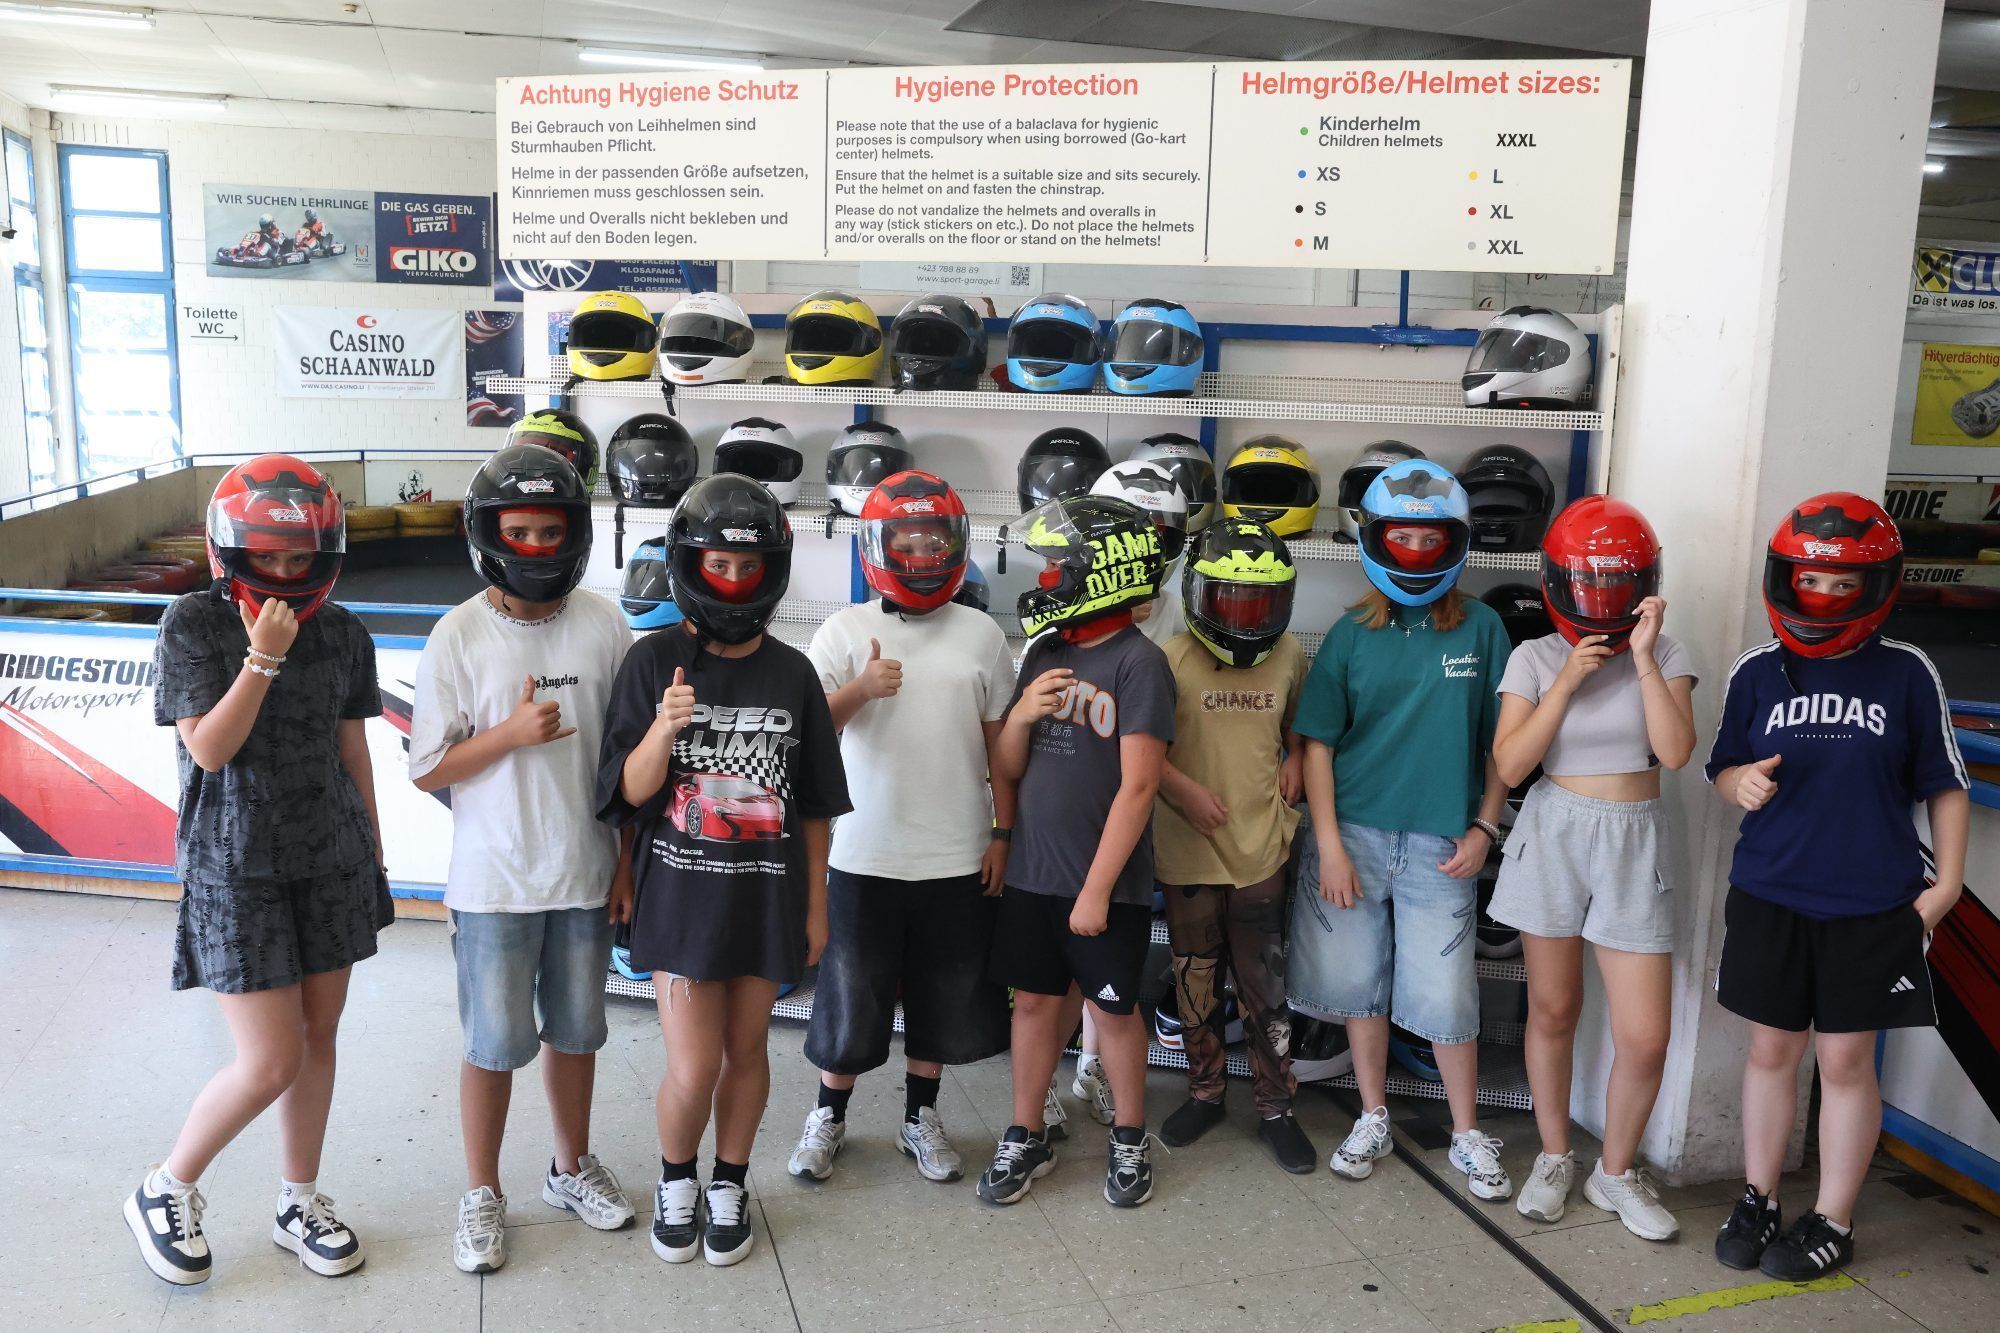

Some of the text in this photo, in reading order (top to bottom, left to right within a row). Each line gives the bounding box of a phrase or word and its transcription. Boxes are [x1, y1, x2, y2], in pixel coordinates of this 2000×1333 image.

[896, 73, 1138, 103] Hygiene Protection
[1243, 70, 1600, 100] Helmgröße/Helmet sizes:
[520, 80, 799, 108] Achtung Hygiene Schutz
[511, 117, 756, 134] Bei Gebrauch von Leihhelmen sind
[836, 118, 1158, 132] Please note that the use of a balaclava for hygienic
[1320, 116, 1420, 131] Kinderhelm
[511, 139, 656, 153] Sturmhauben Pflicht.
[836, 132, 1186, 148] purposes is compulsory when using borrowed (Go-kart
[1319, 134, 1443, 147] Children helmets
[1496, 133, 1537, 147] XXXL
[836, 148, 934, 162] center) helmets.
[512, 164, 808, 181] Helme in der passenden Größe aufsetzen,
[836, 169, 1200, 184] Ensure that the helmet is a suitable size and sits securely.
[1316, 167, 1340, 182] XS
[1493, 169, 1503, 184] L
[512, 184, 764, 201] Kinnriemen muss geschlossen sein.
[836, 183, 1104, 197] Put the helmet on and fasten the chinstrap.
[217, 193, 369, 210] WIR SUCHEN LEHRLINGE
[381, 201, 476, 215] DIE GAS GEBEN.
[1315, 201, 1326, 216] S
[513, 211, 788, 225] Helme und Overalls nicht bekleben und
[835, 204, 1156, 217] Please do not vandalize the helmets and overalls in
[1490, 204, 1514, 219] XL
[414, 220, 448, 233] JETZT
[835, 218, 1194, 233] any way (stick stickers on etc.). Do not place the helmets
[513, 231, 697, 247] nicht auf den Boden legen.
[835, 232, 1161, 246] and/or overalls on the floor or stand on the helmets!
[1313, 236, 1329, 250] M
[1487, 239, 1524, 255] XXL
[392, 249, 477, 273] GIKO
[405, 270, 464, 278] VERPACKUNGEN
[620, 266, 675, 275] KLOSAFANG
[939, 265, 954, 274] 788
[633, 276, 682, 284] DORNBIRN
[916, 275, 1000, 286] www.sport-garage.li
[1912, 294, 1998, 310] Da ist was los.
[184, 306, 238, 321] Toilette
[198, 321, 225, 335] WC
[329, 329, 405, 354] CASINO
[300, 356, 435, 377] SCHAANWALD
[1088, 526, 1161, 570] GAME
[1085, 560, 1148, 599] OVER
[541, 673, 579, 691] Angeles
[1, 685, 146, 718] Motorsport
[656, 702, 793, 733] PEED
[1764, 693, 1887, 737] ADIDAS
[689, 730, 801, 764] LIMIT
